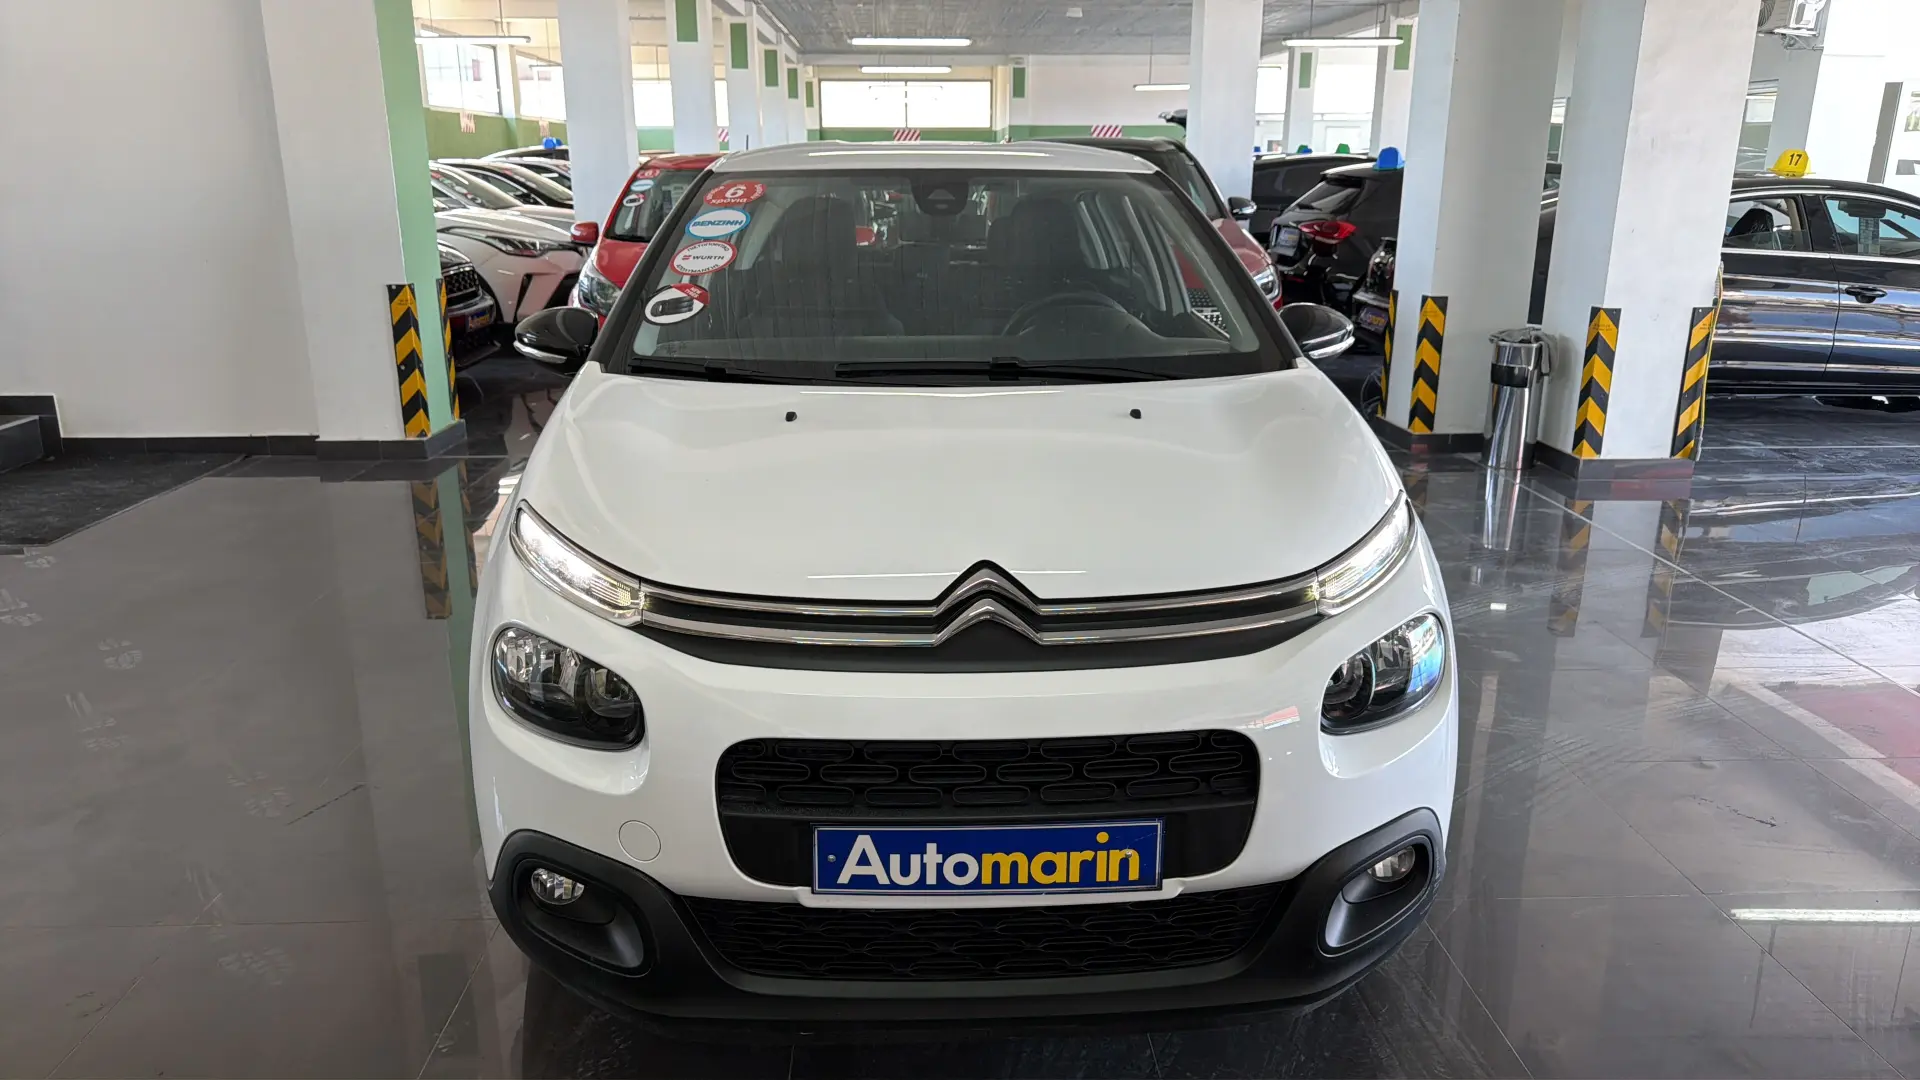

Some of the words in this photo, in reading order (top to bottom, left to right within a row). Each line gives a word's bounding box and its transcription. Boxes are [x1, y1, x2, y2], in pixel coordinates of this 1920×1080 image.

[1788, 152, 1803, 166] 17
[724, 186, 747, 198] 6
[836, 831, 1140, 886] Automarin
